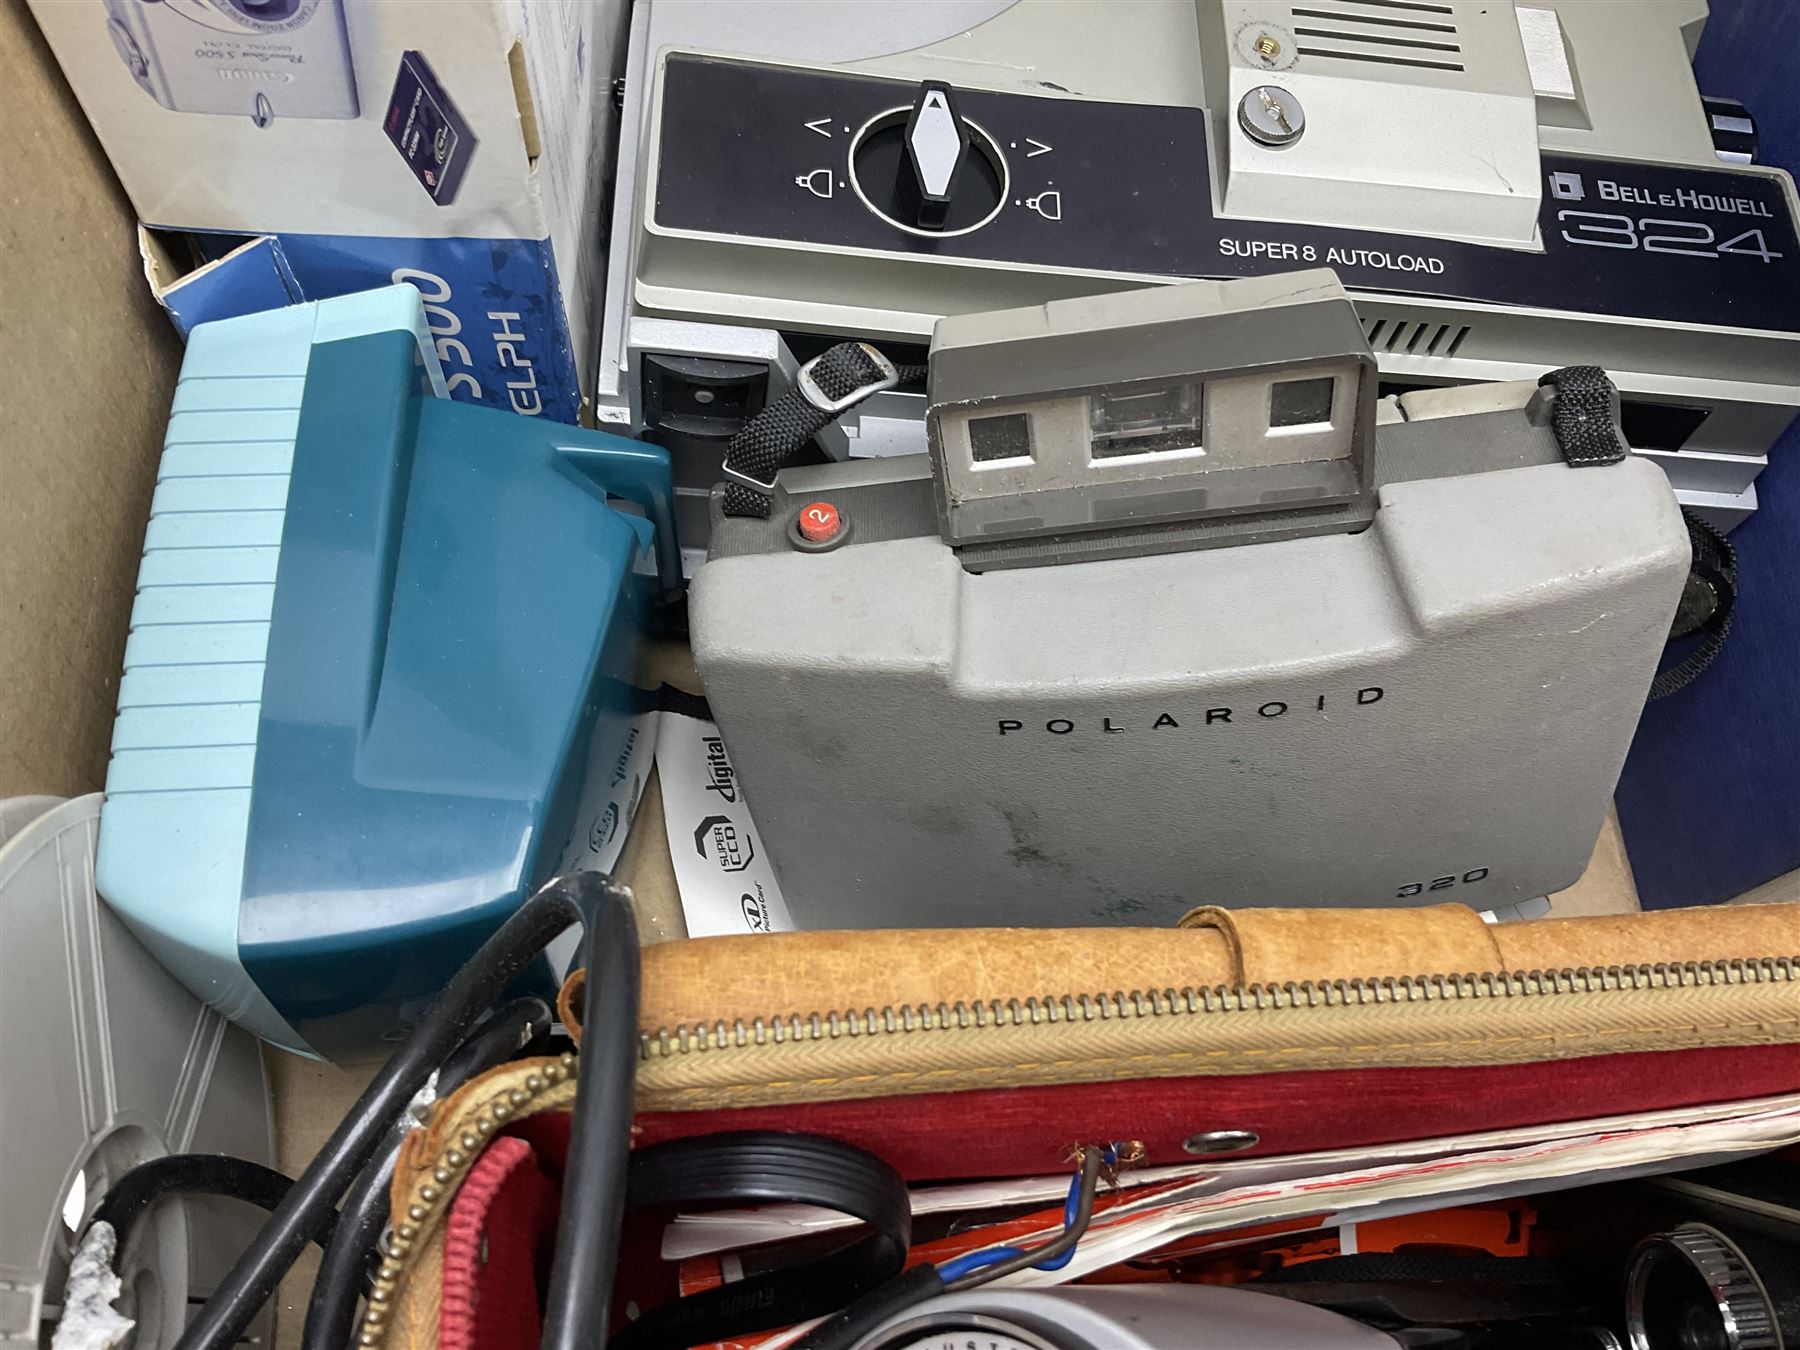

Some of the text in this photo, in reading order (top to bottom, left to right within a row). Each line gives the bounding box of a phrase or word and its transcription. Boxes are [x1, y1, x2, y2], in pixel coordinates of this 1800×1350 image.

[1218, 237, 1446, 275] SUPER 8 AUTOLOAD
[1557, 209, 1784, 264] 324
[487, 311, 543, 416] ELPH
[808, 508, 831, 524] 2
[997, 686, 1385, 737] POLAROID
[702, 736, 736, 804] digital
[713, 826, 730, 867] SUPER
[723, 826, 743, 867] CCD
[1396, 866, 1490, 898] 320
[759, 903, 772, 932] Picture
